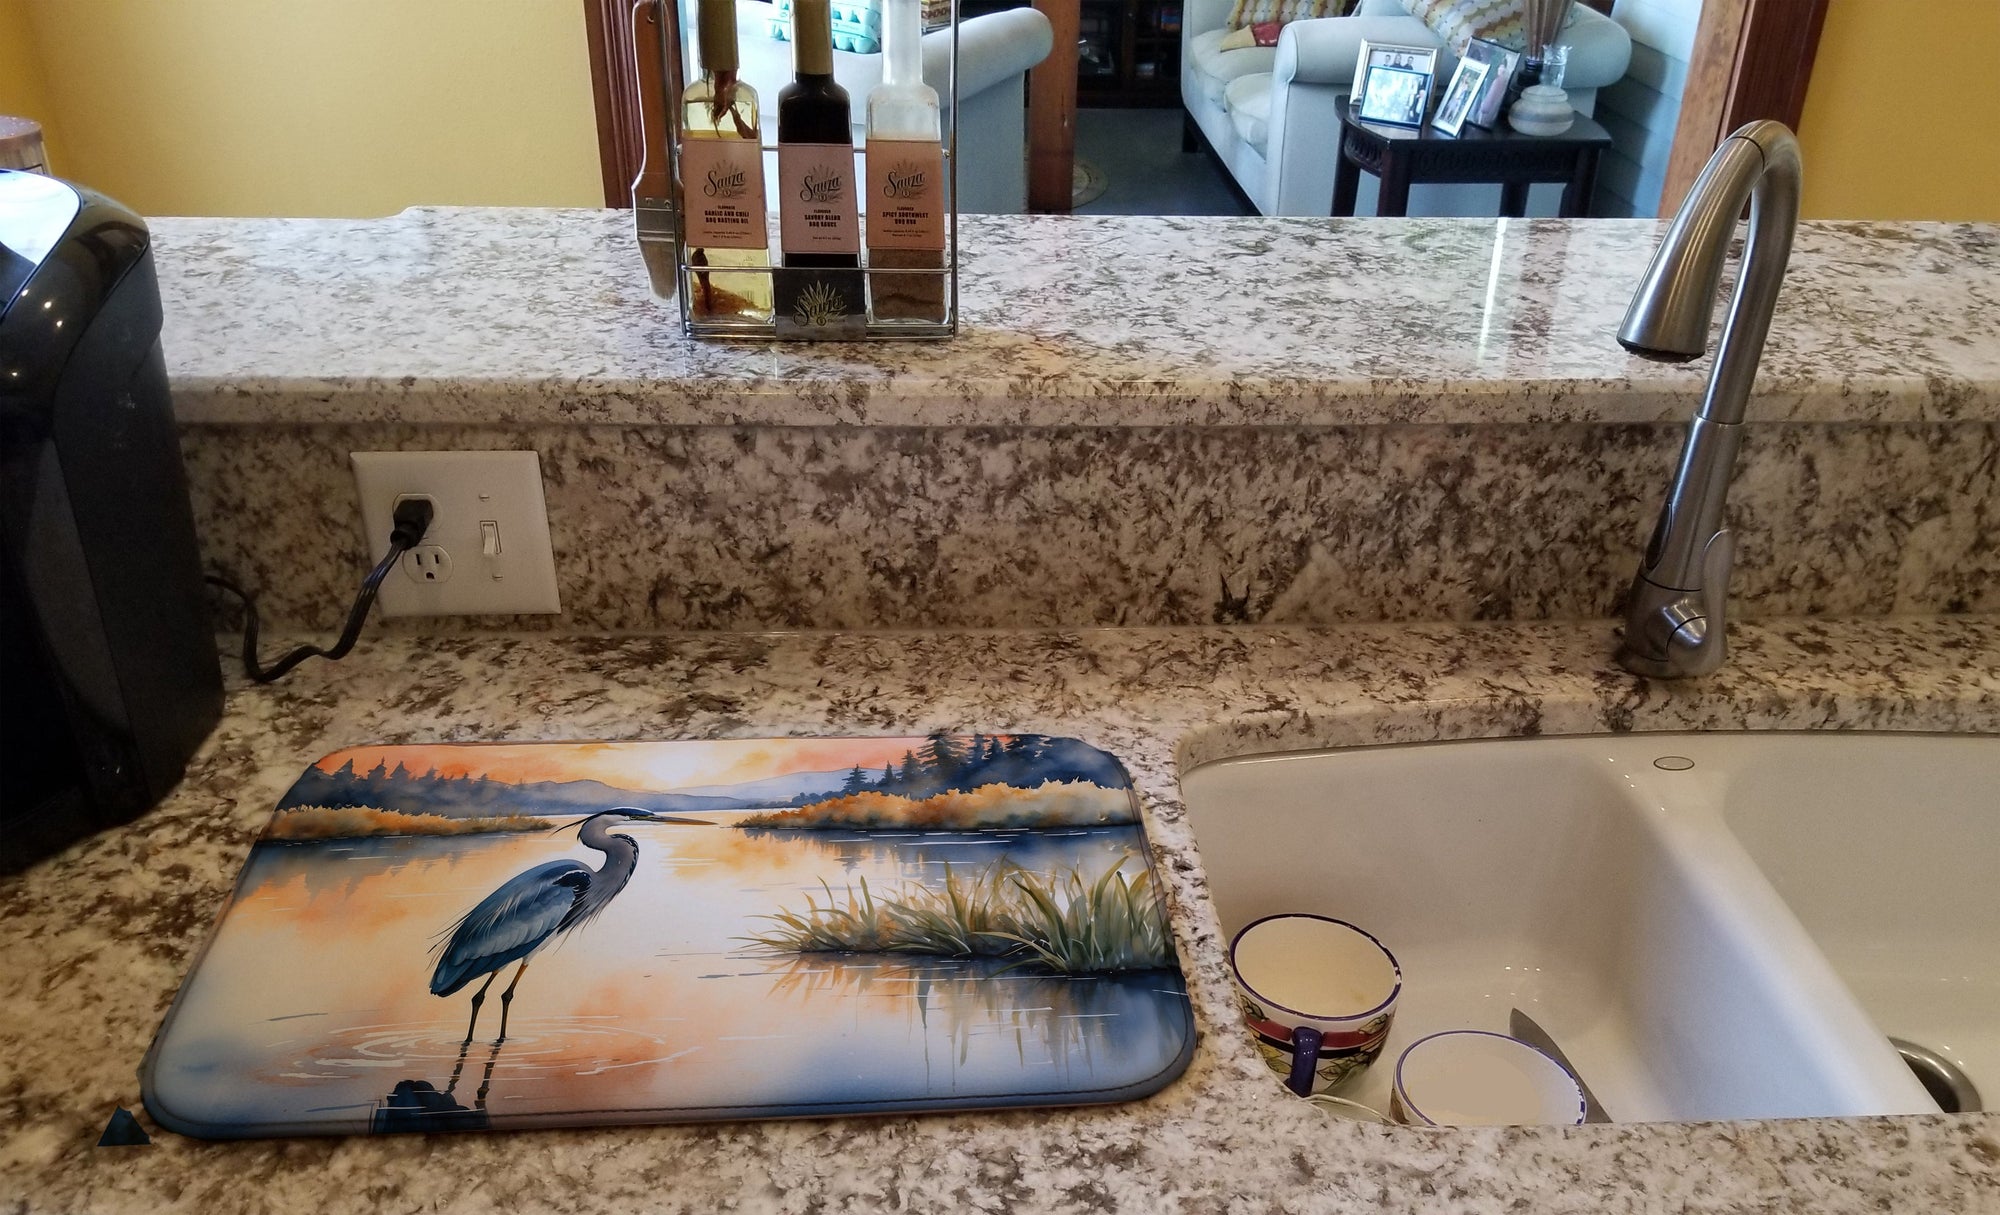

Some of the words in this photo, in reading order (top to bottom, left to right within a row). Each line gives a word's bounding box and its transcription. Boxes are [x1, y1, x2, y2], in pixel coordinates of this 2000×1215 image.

[703, 170, 746, 197] Sauza
[800, 175, 842, 202] Sauza
[884, 170, 925, 198] Sauza
